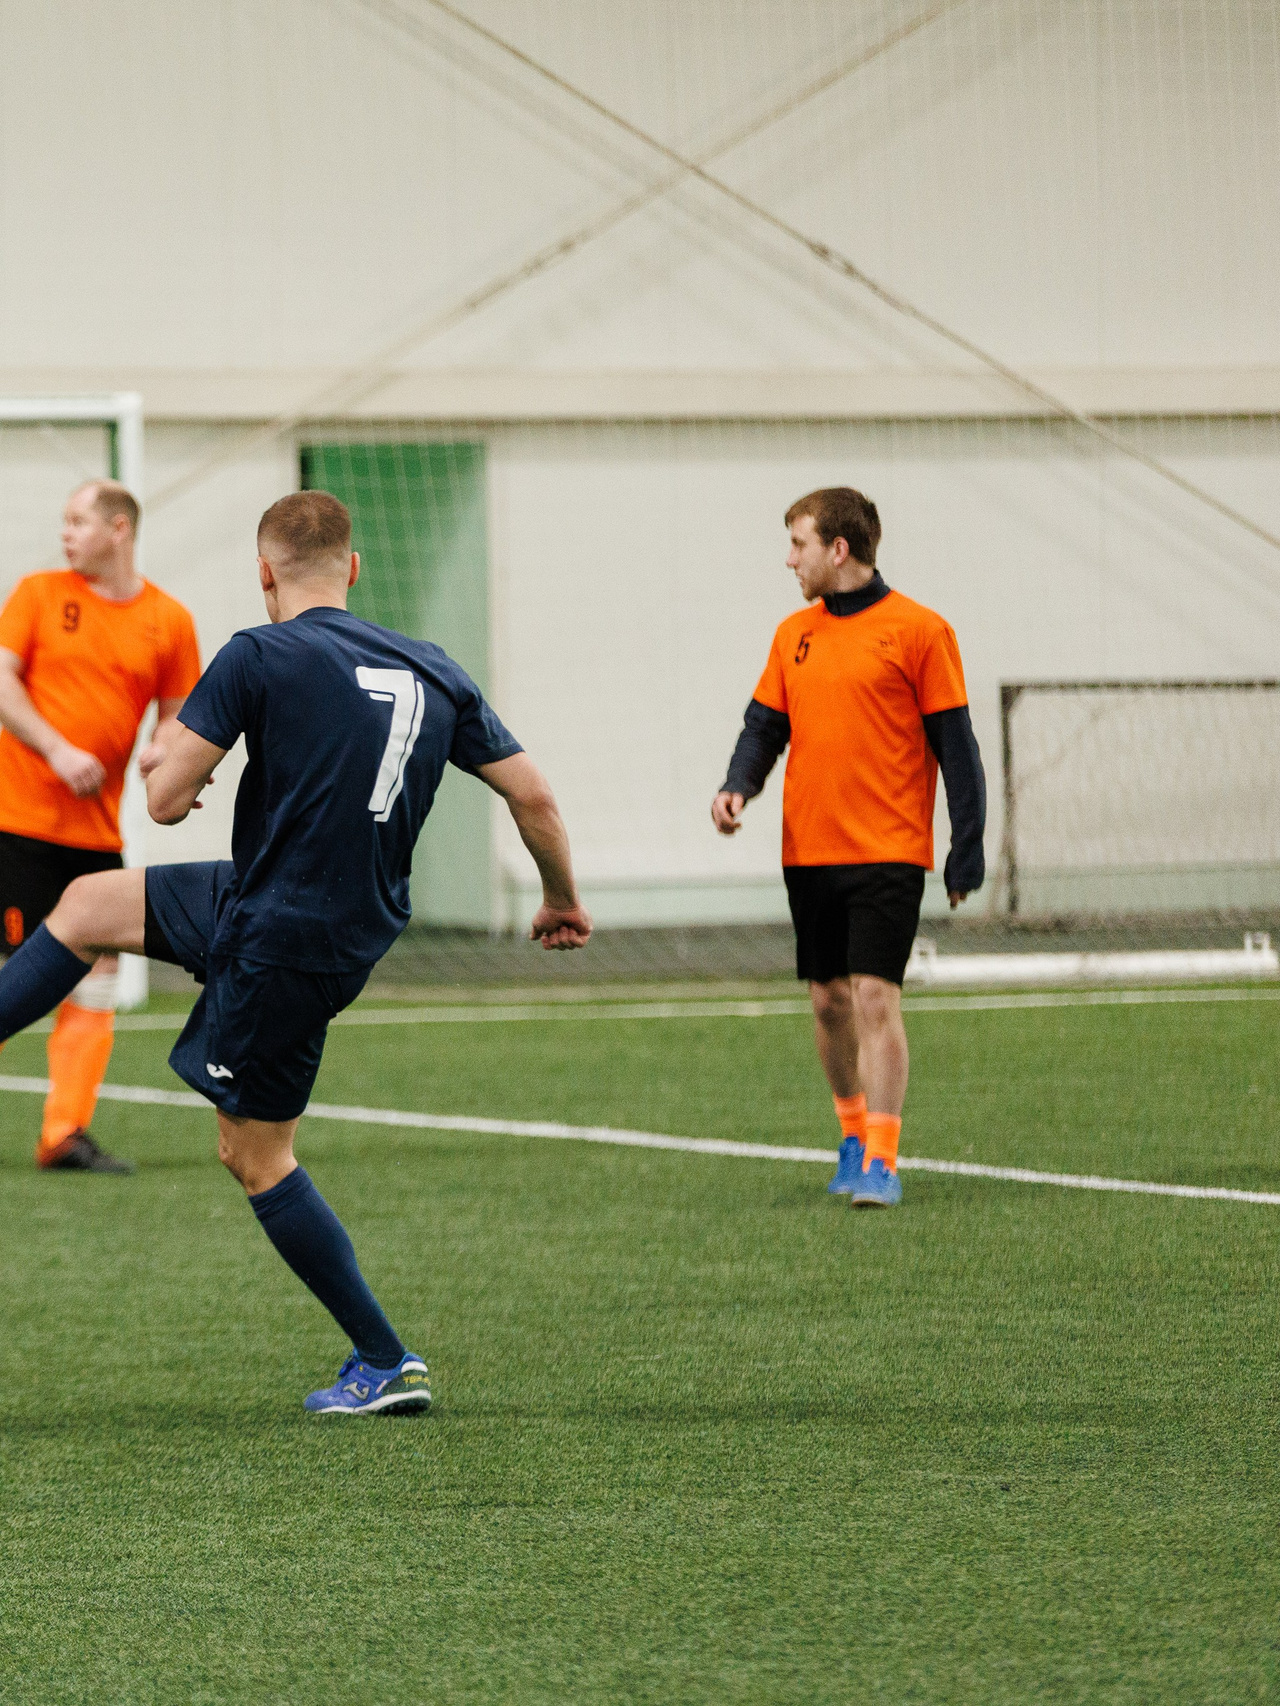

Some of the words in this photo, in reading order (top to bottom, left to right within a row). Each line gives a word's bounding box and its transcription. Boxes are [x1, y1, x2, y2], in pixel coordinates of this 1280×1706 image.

[63, 601, 81, 633] 9
[795, 630, 814, 665] 5
[355, 665, 426, 823] 7
